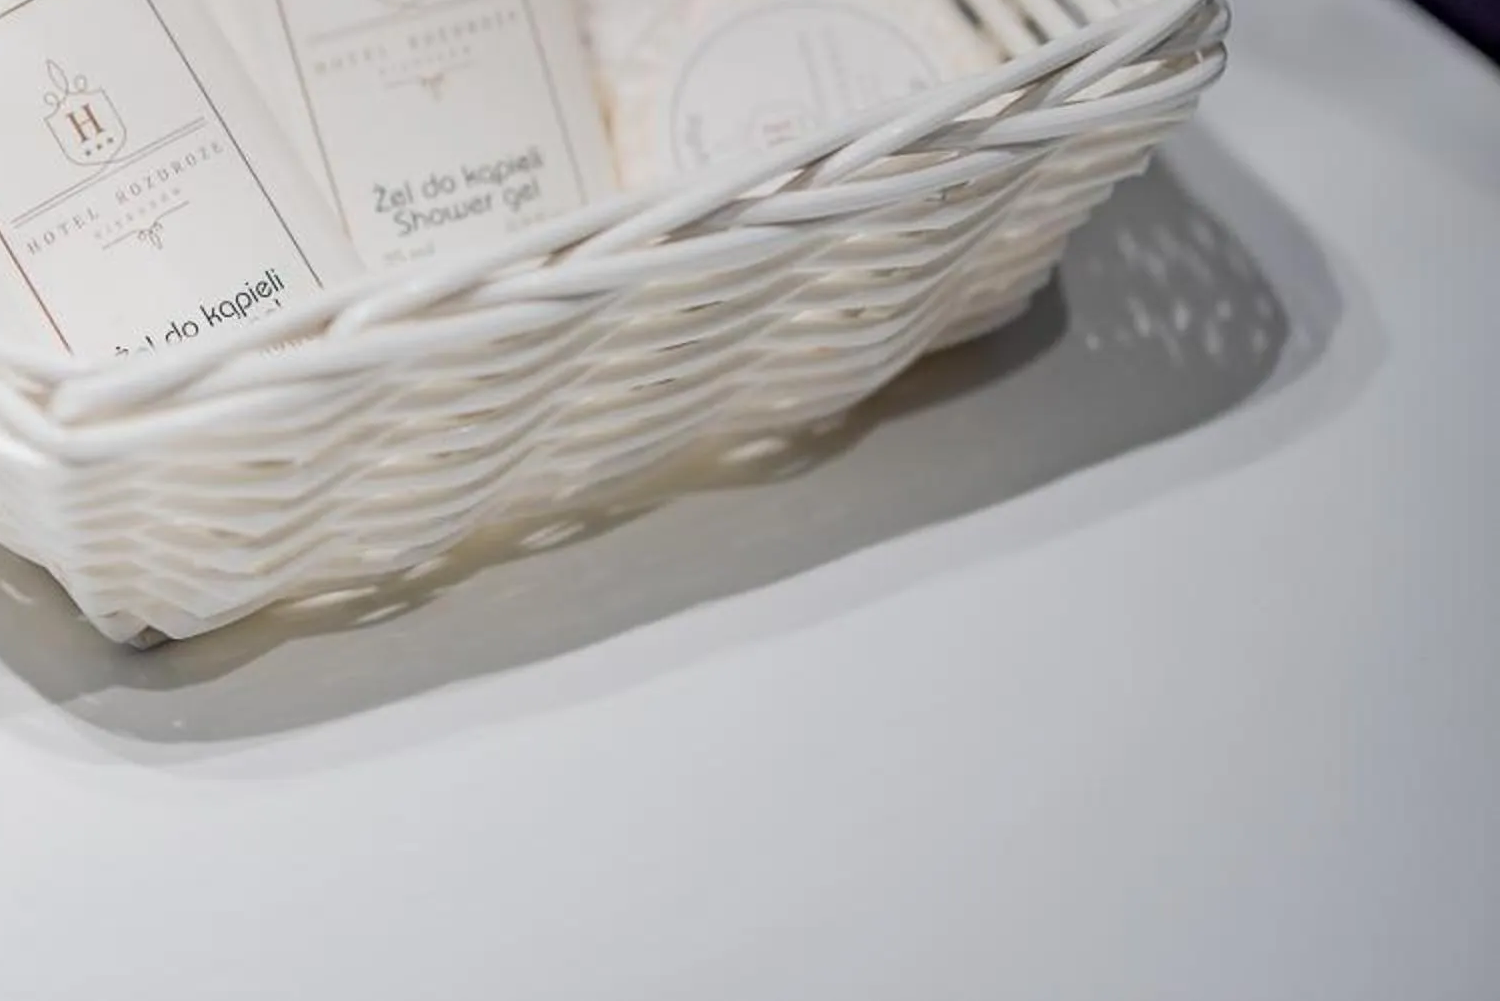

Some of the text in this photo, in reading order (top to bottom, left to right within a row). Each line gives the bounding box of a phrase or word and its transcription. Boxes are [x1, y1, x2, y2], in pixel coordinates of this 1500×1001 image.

[65, 103, 106, 143] H
[393, 192, 493, 239] Shower
[501, 175, 542, 214] gel
[421, 171, 457, 200] do
[26, 206, 99, 255] HOTEL
[200, 267, 286, 328] kąpieli
